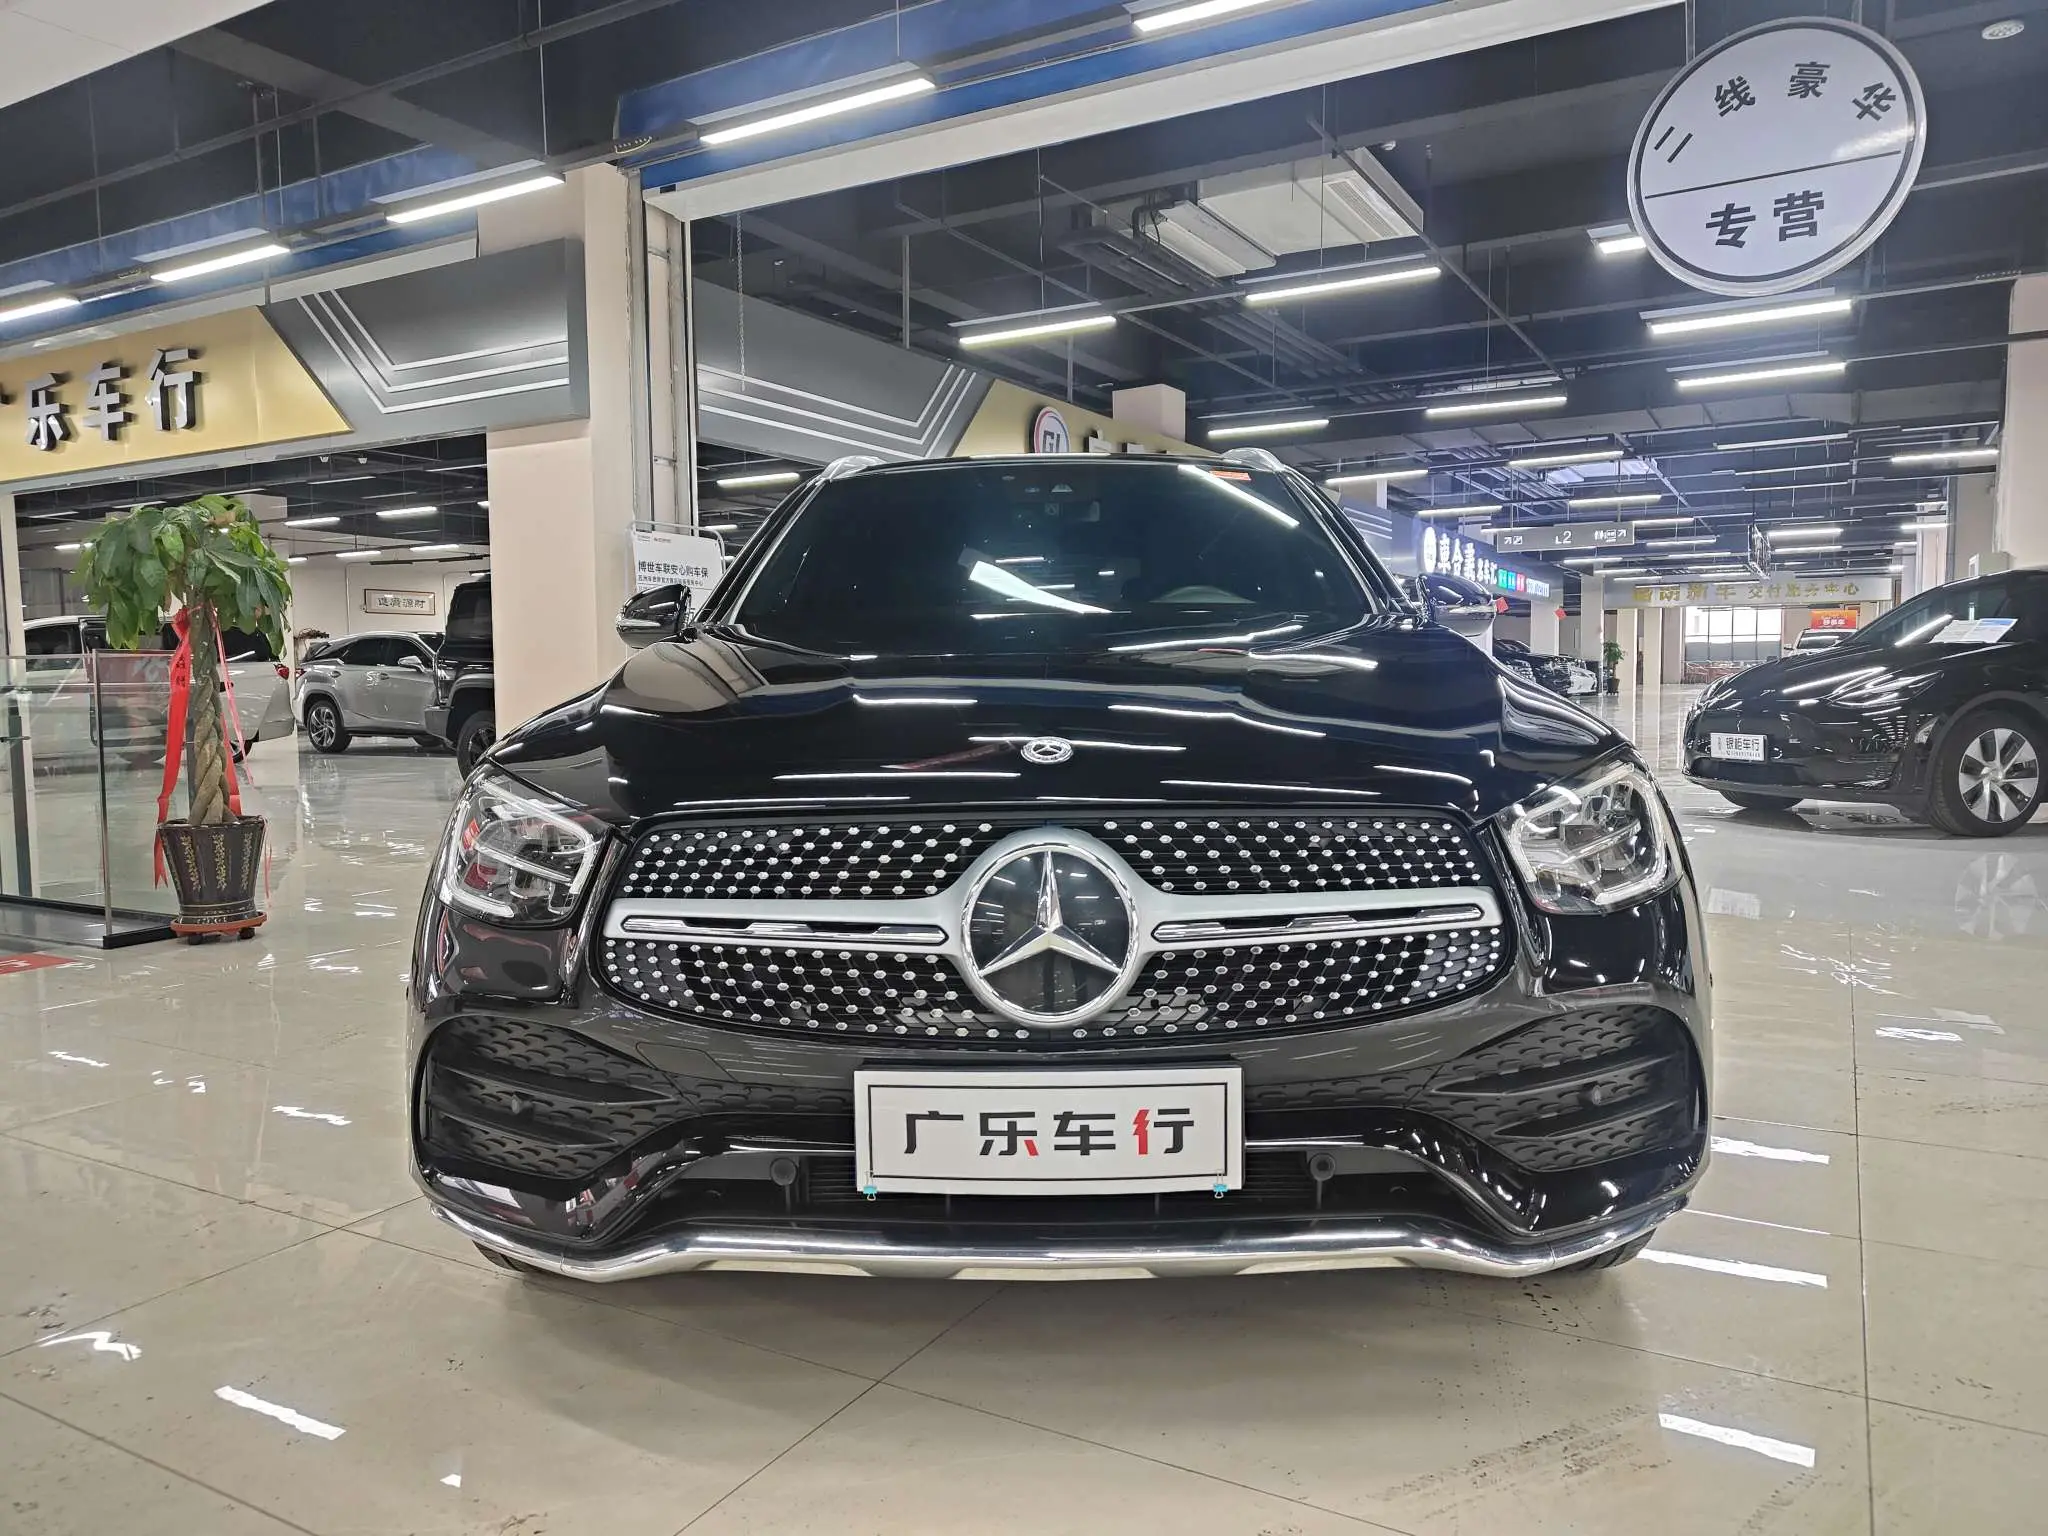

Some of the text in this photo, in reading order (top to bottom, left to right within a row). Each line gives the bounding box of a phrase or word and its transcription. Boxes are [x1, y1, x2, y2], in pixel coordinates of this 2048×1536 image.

[1654, 61, 1897, 163] 二线豪华
[1706, 190, 1825, 248] 专营
[0, 348, 199, 450] 乐车行
[1555, 530, 1572, 545] L2
[903, 1108, 1195, 1157] 广乐车行
